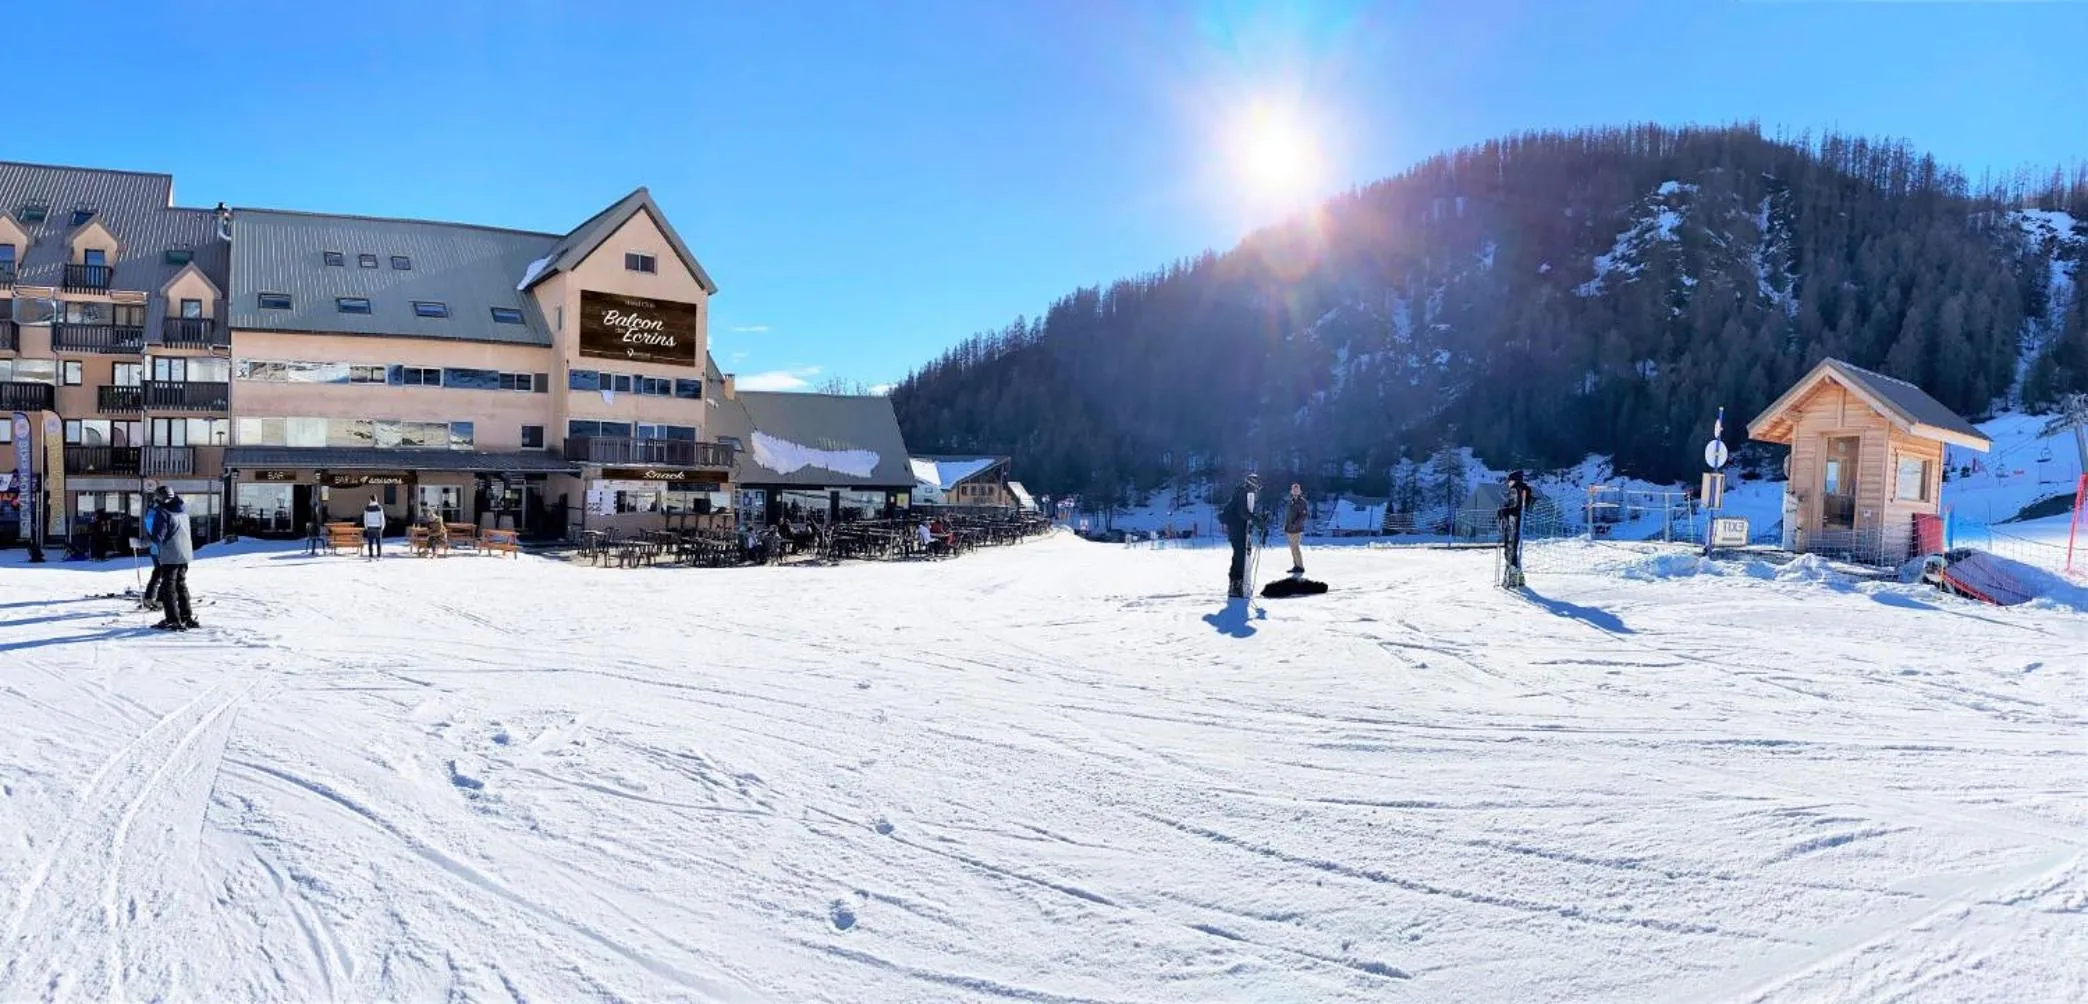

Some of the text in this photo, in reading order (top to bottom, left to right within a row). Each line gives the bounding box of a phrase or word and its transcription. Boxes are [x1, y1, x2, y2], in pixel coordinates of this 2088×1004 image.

[603, 310, 664, 330] Balcon
[267, 471, 285, 480] BAR
[643, 470, 685, 480] Snack
